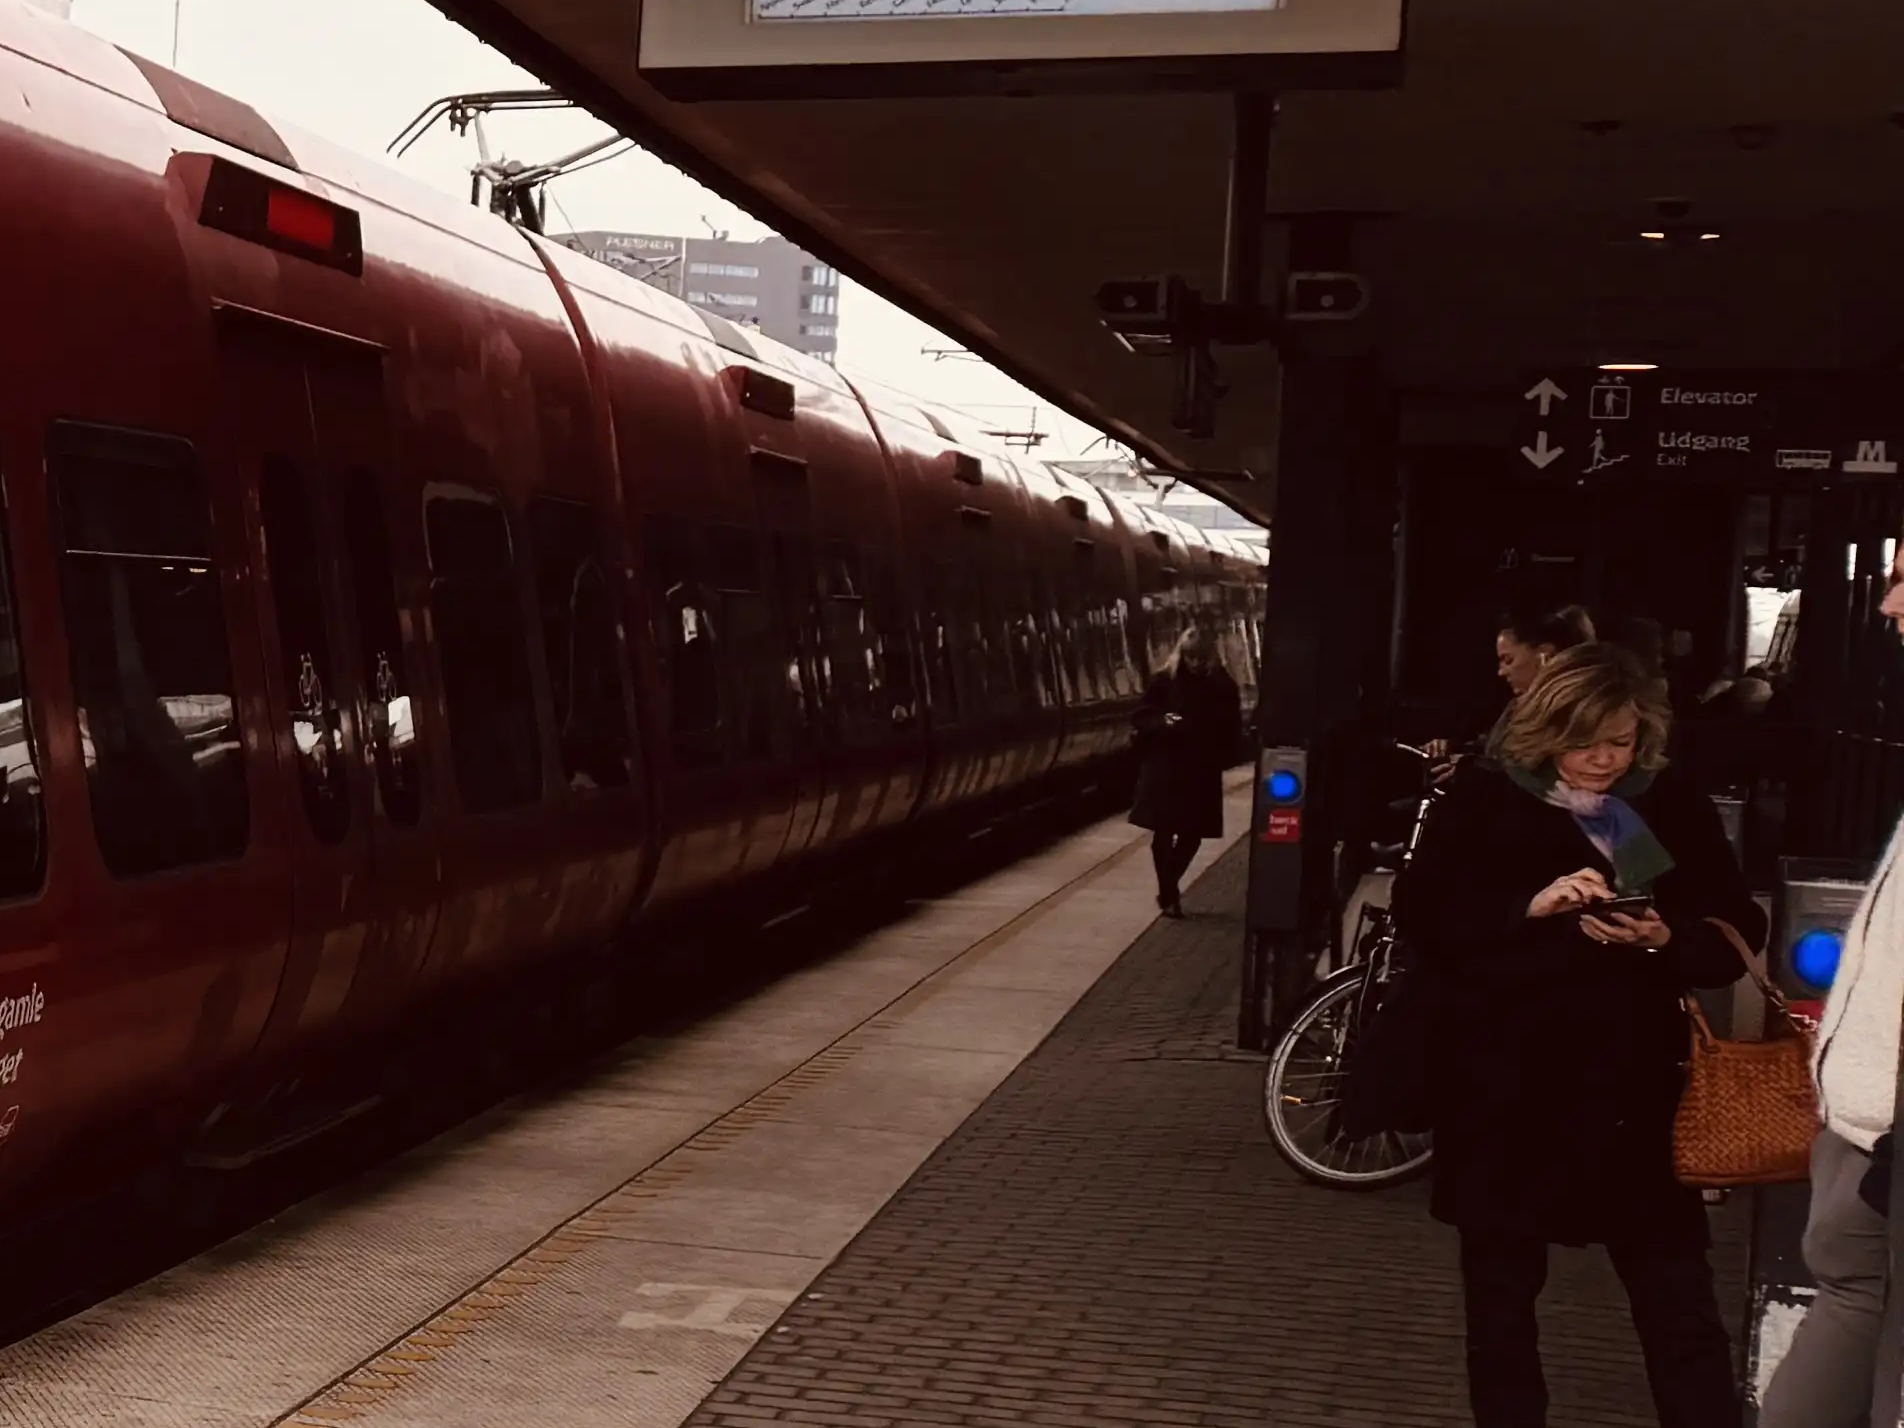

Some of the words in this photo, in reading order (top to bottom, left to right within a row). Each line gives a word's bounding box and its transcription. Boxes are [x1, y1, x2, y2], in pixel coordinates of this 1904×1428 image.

[1660, 387, 1758, 405] Elevator
[1658, 431, 1751, 452] Udgang
[1656, 453, 1687, 466] Exit
